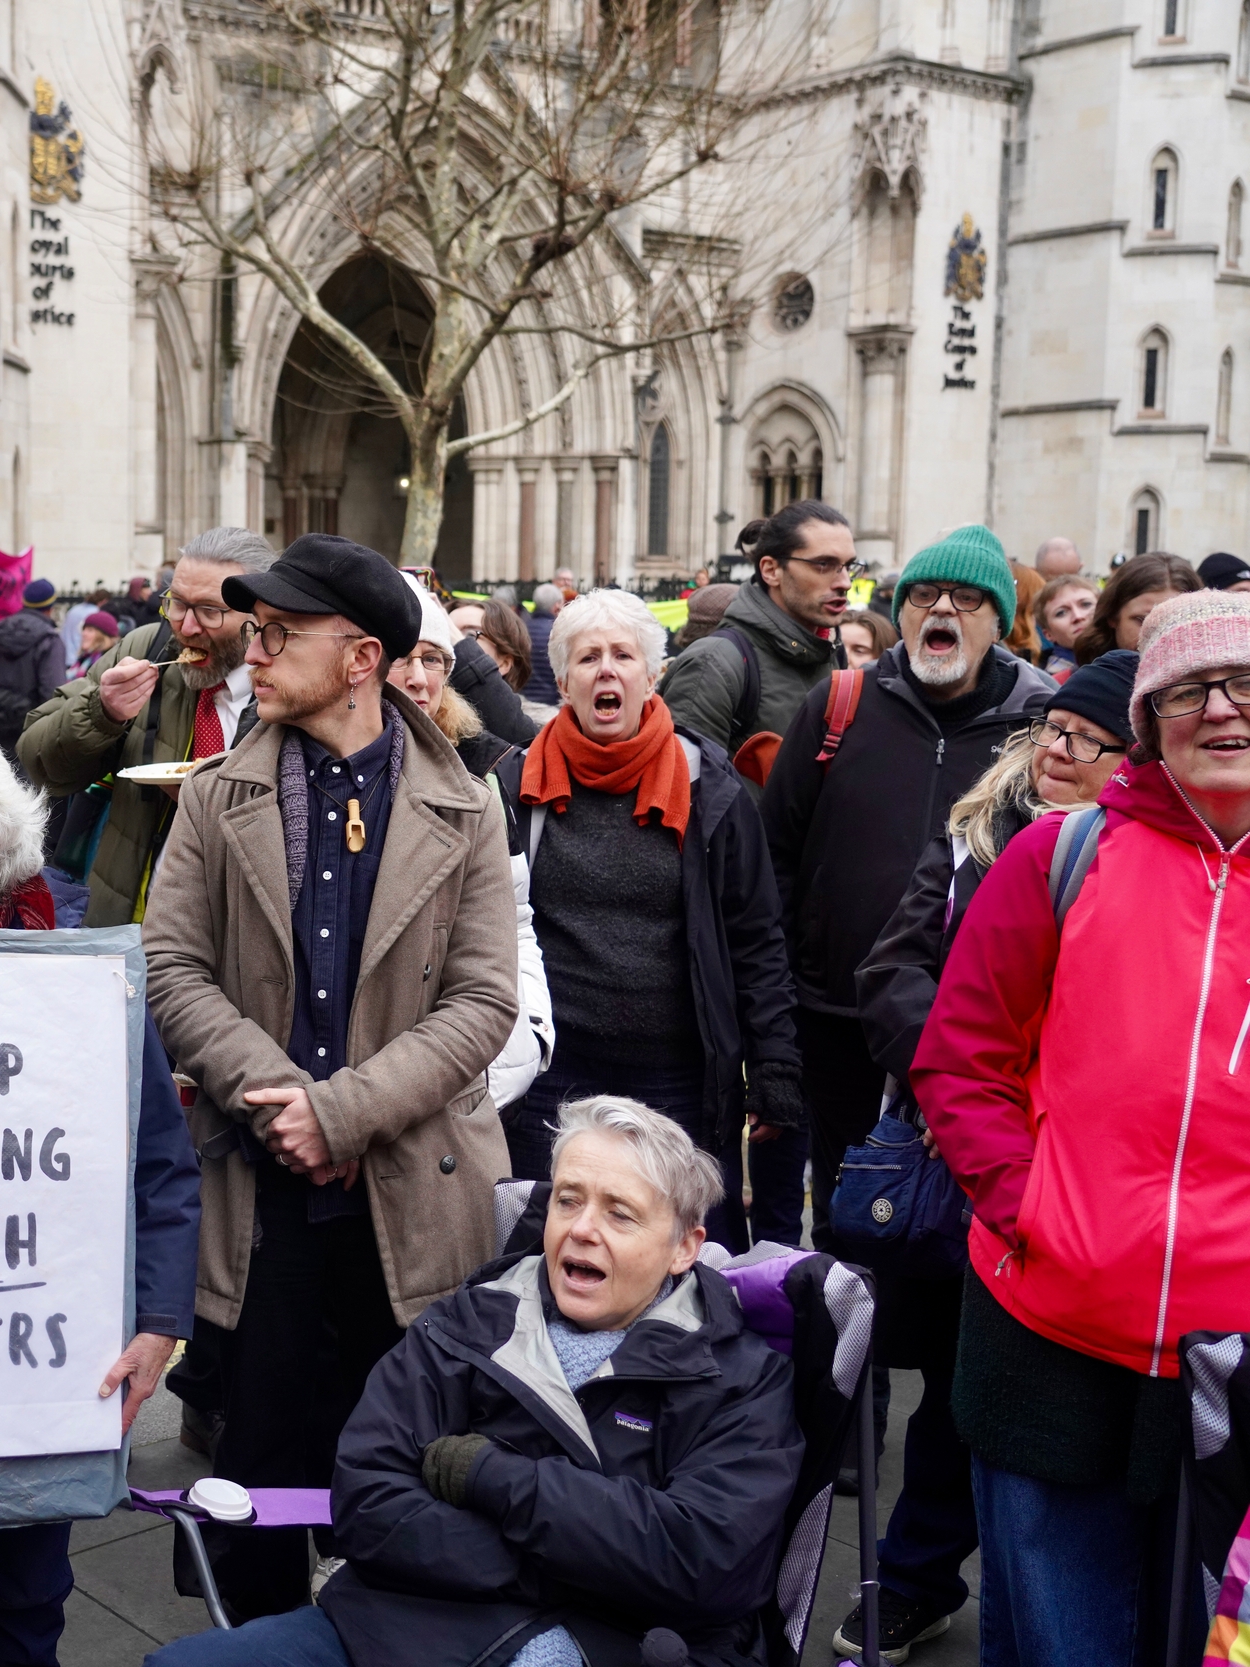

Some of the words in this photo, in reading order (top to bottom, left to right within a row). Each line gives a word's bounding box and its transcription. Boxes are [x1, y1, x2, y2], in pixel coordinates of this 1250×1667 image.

[30, 237, 69, 258] oyal
[30, 263, 75, 281] ourts
[32, 281, 54, 300] of
[31, 306, 75, 327] stice
[952, 305, 971, 320] The
[616, 1419, 650, 1432] patagonia
